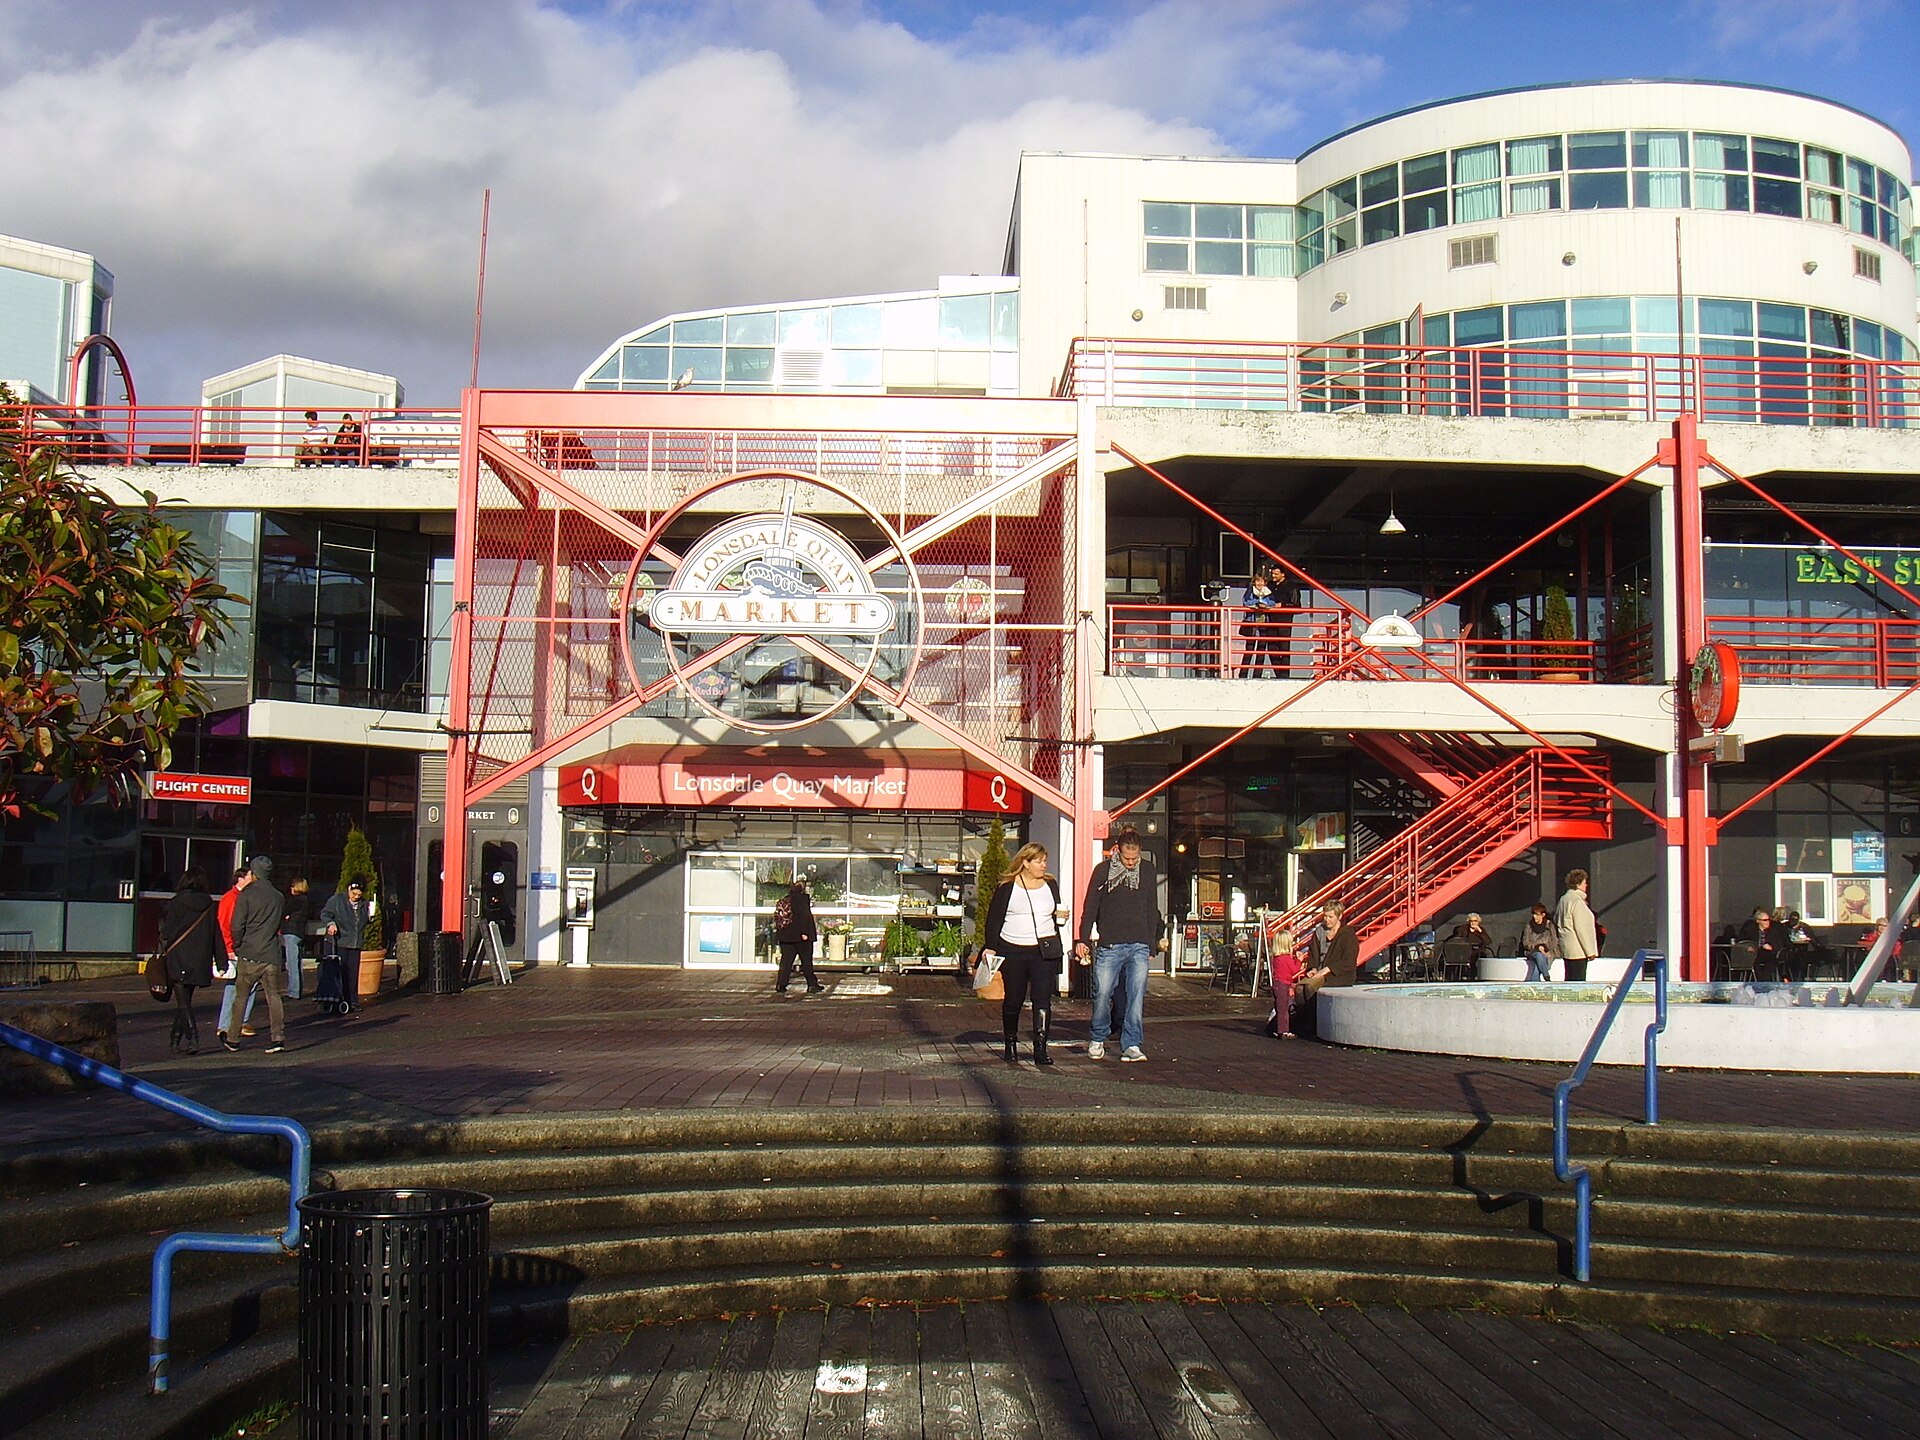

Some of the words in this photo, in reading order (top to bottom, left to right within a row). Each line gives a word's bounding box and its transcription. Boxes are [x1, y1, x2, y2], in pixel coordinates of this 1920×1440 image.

[694, 530, 799, 583] LONSDALE
[806, 540, 855, 589] QUAY
[1796, 555, 1882, 584] EAST
[680, 599, 865, 624] MARKET
[155, 780, 199, 793] FLIGHT
[201, 783, 248, 796] CENTRE
[673, 770, 764, 793] Lonsdale
[771, 771, 826, 800] Quay
[832, 774, 907, 796] Market
[468, 811, 496, 820] RKET
